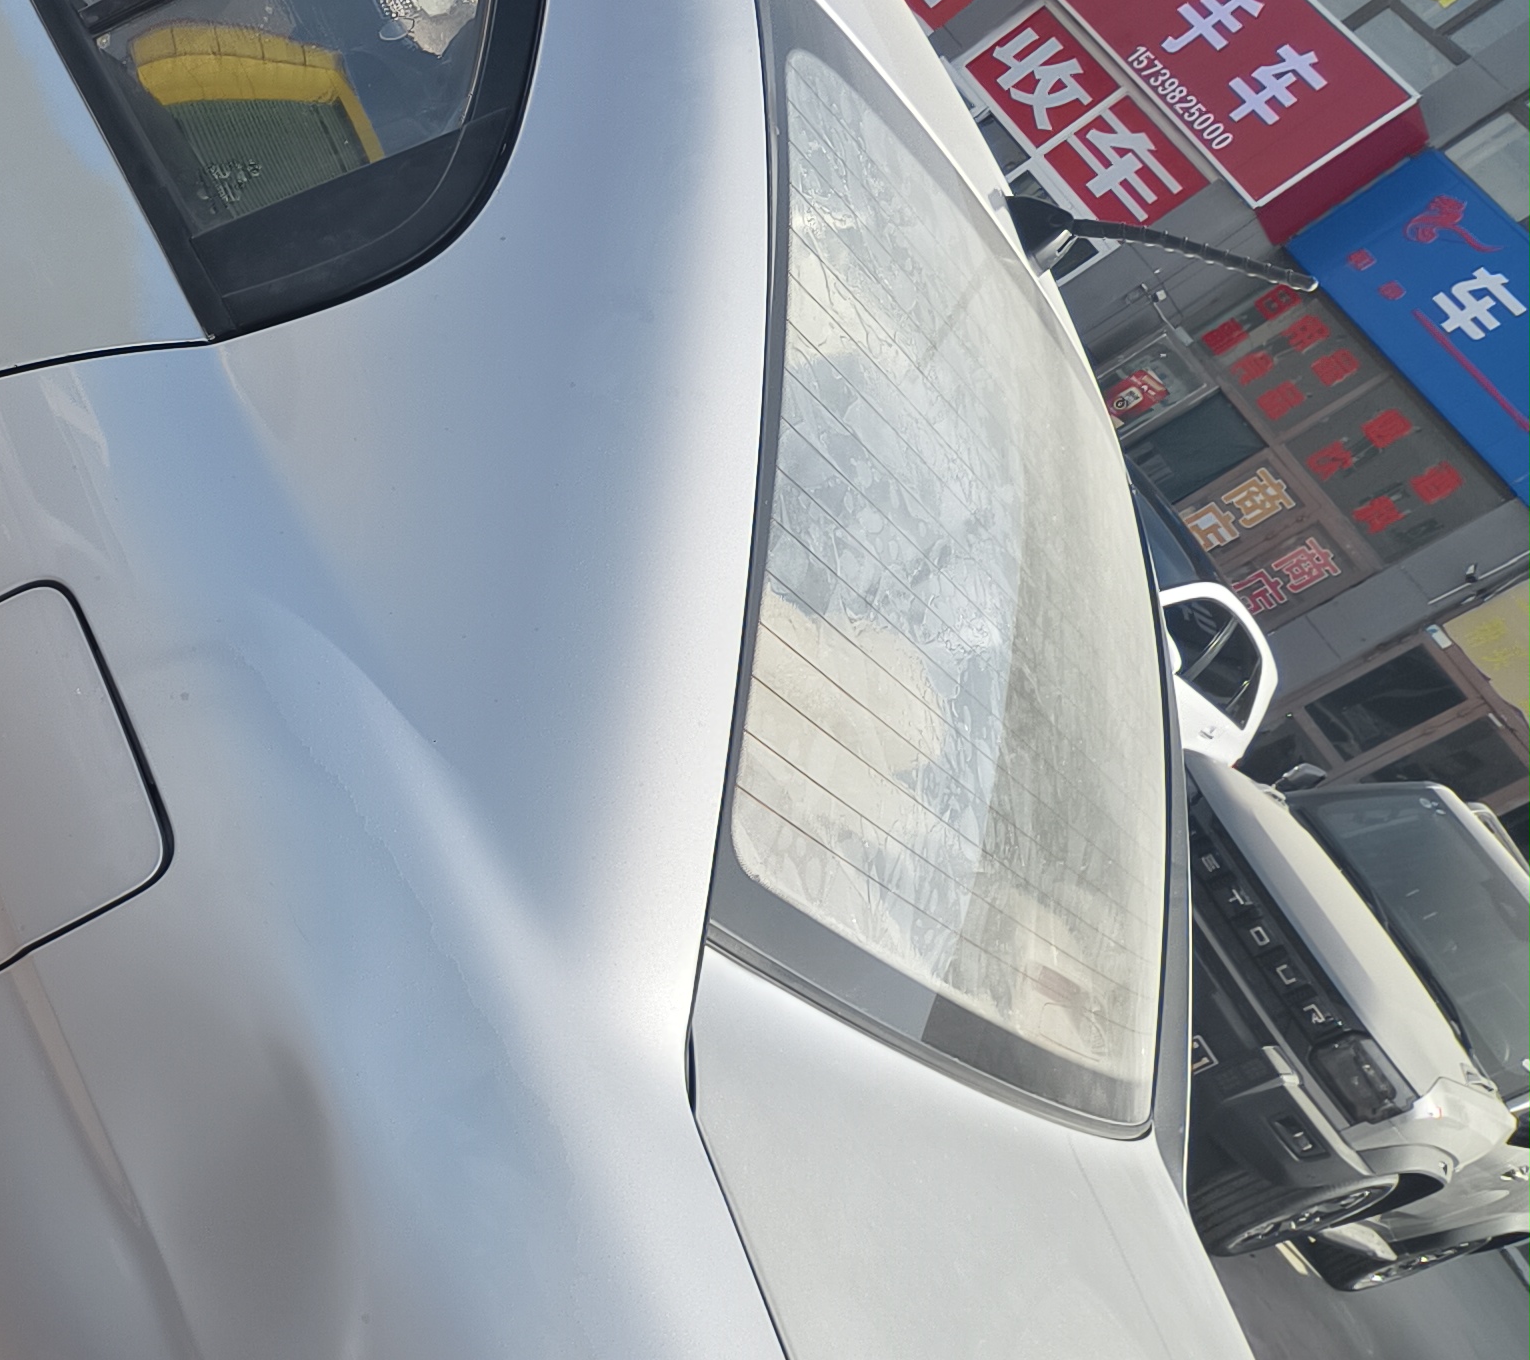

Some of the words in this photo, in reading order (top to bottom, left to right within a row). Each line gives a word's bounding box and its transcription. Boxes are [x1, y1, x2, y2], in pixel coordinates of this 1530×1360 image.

[1127, 46, 1233, 150] 15739825000
[1432, 267, 1527, 341] 车
[1178, 468, 1296, 552] 商店
[1231, 537, 1341, 615] 商店
[1190, 830, 1327, 1026] ETOUR
